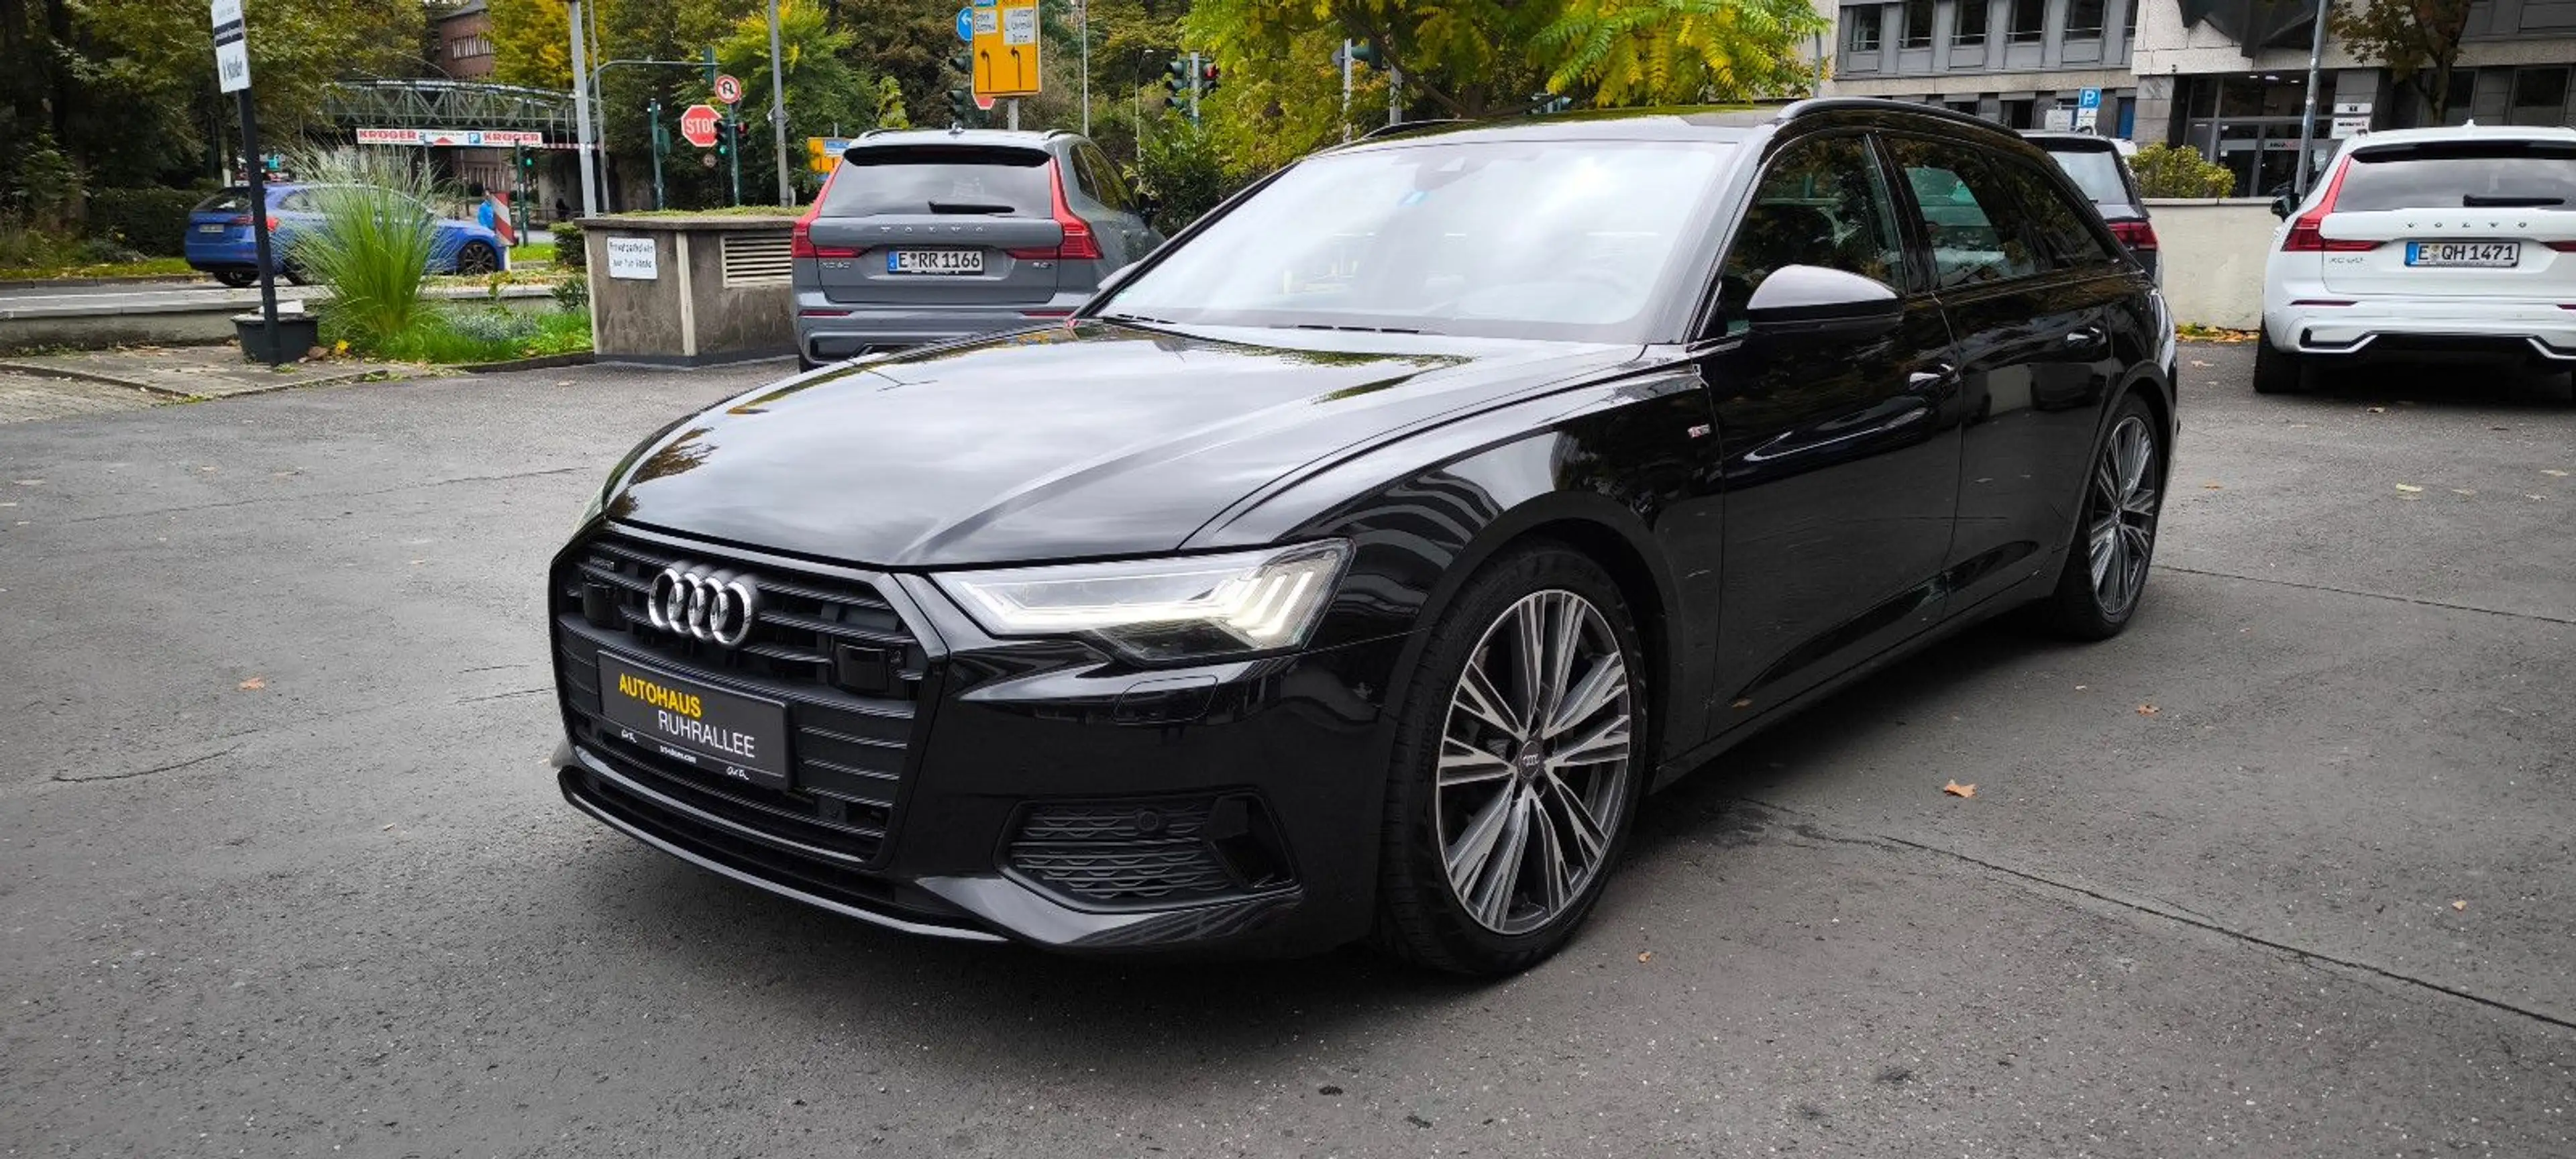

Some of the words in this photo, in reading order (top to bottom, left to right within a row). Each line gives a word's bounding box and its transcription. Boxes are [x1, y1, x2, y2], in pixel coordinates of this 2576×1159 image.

[899, 252, 908, 268] E
[919, 252, 939, 268] RR
[942, 252, 980, 268] 1166
[2418, 245, 2428, 260] E
[2442, 245, 2466, 261] QH
[2469, 245, 2514, 260] 1471
[619, 672, 702, 718] AUTOHAUS
[657, 710, 755, 758] RUHRALLEE
